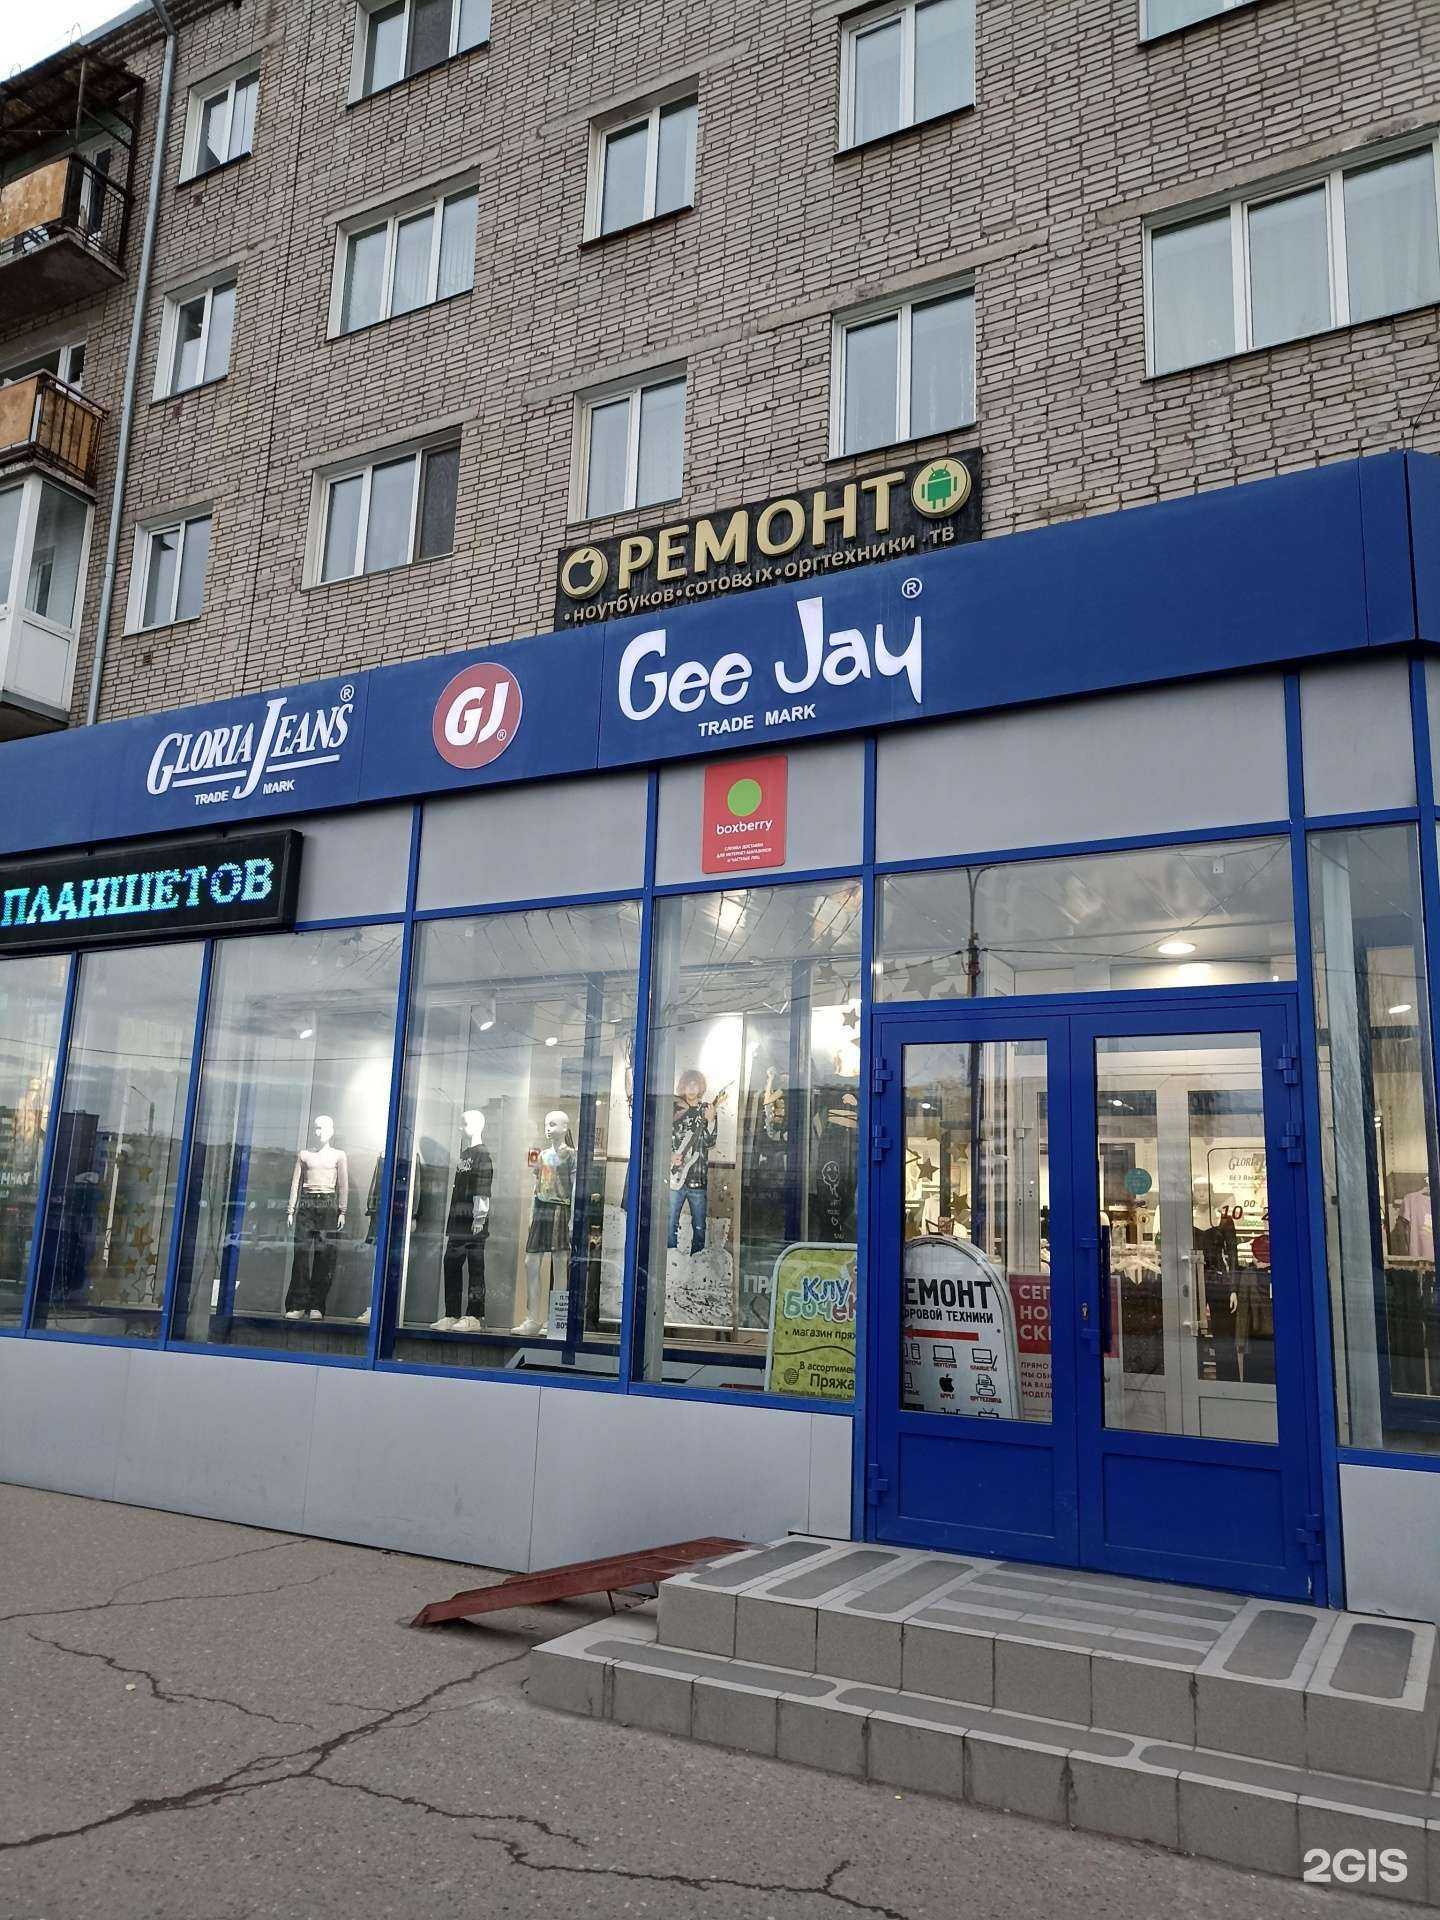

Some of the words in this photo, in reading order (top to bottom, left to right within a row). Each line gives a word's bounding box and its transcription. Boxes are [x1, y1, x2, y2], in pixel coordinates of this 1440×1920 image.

[616, 471, 906, 591] РЕМОНТ
[573, 588, 674, 622] ноутбуков
[784, 534, 915, 577] оргтехники
[618, 629, 753, 721] Gee
[774, 596, 923, 705] Jay
[444, 681, 510, 747] GJ
[698, 714, 754, 737] TRADE
[765, 704, 817, 726] MARK
[146, 722, 254, 795] GLORIA
[232, 696, 354, 800] JEANS
[194, 790, 229, 806] TRADE
[262, 779, 296, 795] MARK
[716, 819, 773, 835] boxberry
[1, 857, 275, 926] ПЛАНШЕТОВ
[903, 1277, 992, 1309] ЕМОНТ
[945, 1310, 994, 1323] ТЕХНИКИ
[792, 1328, 832, 1338] магазин
[1020, 1361, 1049, 1370] ПРЯМО
[809, 1373, 855, 1391] Пряжа
